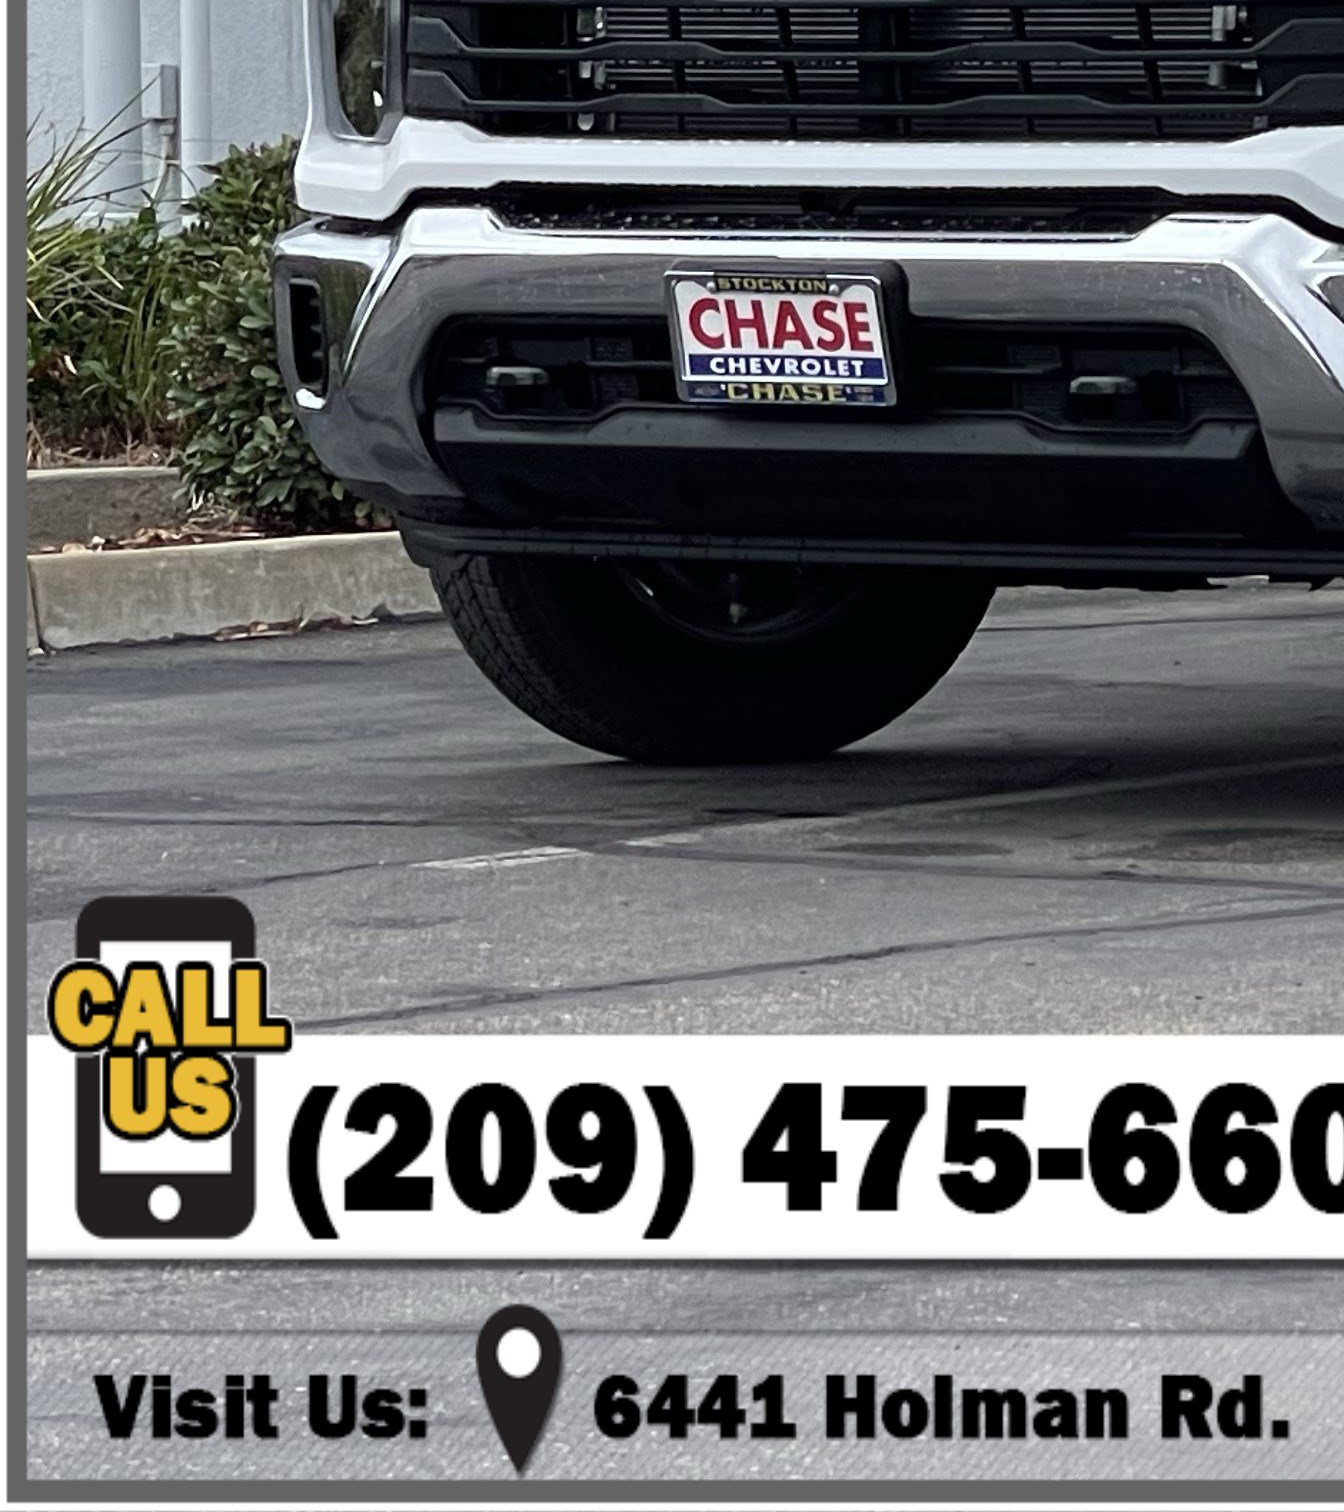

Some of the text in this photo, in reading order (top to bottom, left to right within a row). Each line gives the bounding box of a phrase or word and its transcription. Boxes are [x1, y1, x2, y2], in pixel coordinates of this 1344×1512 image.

[716, 276, 828, 293] STOCKTON
[688, 298, 875, 352] CHASE
[709, 357, 864, 377] CHEVROLET
